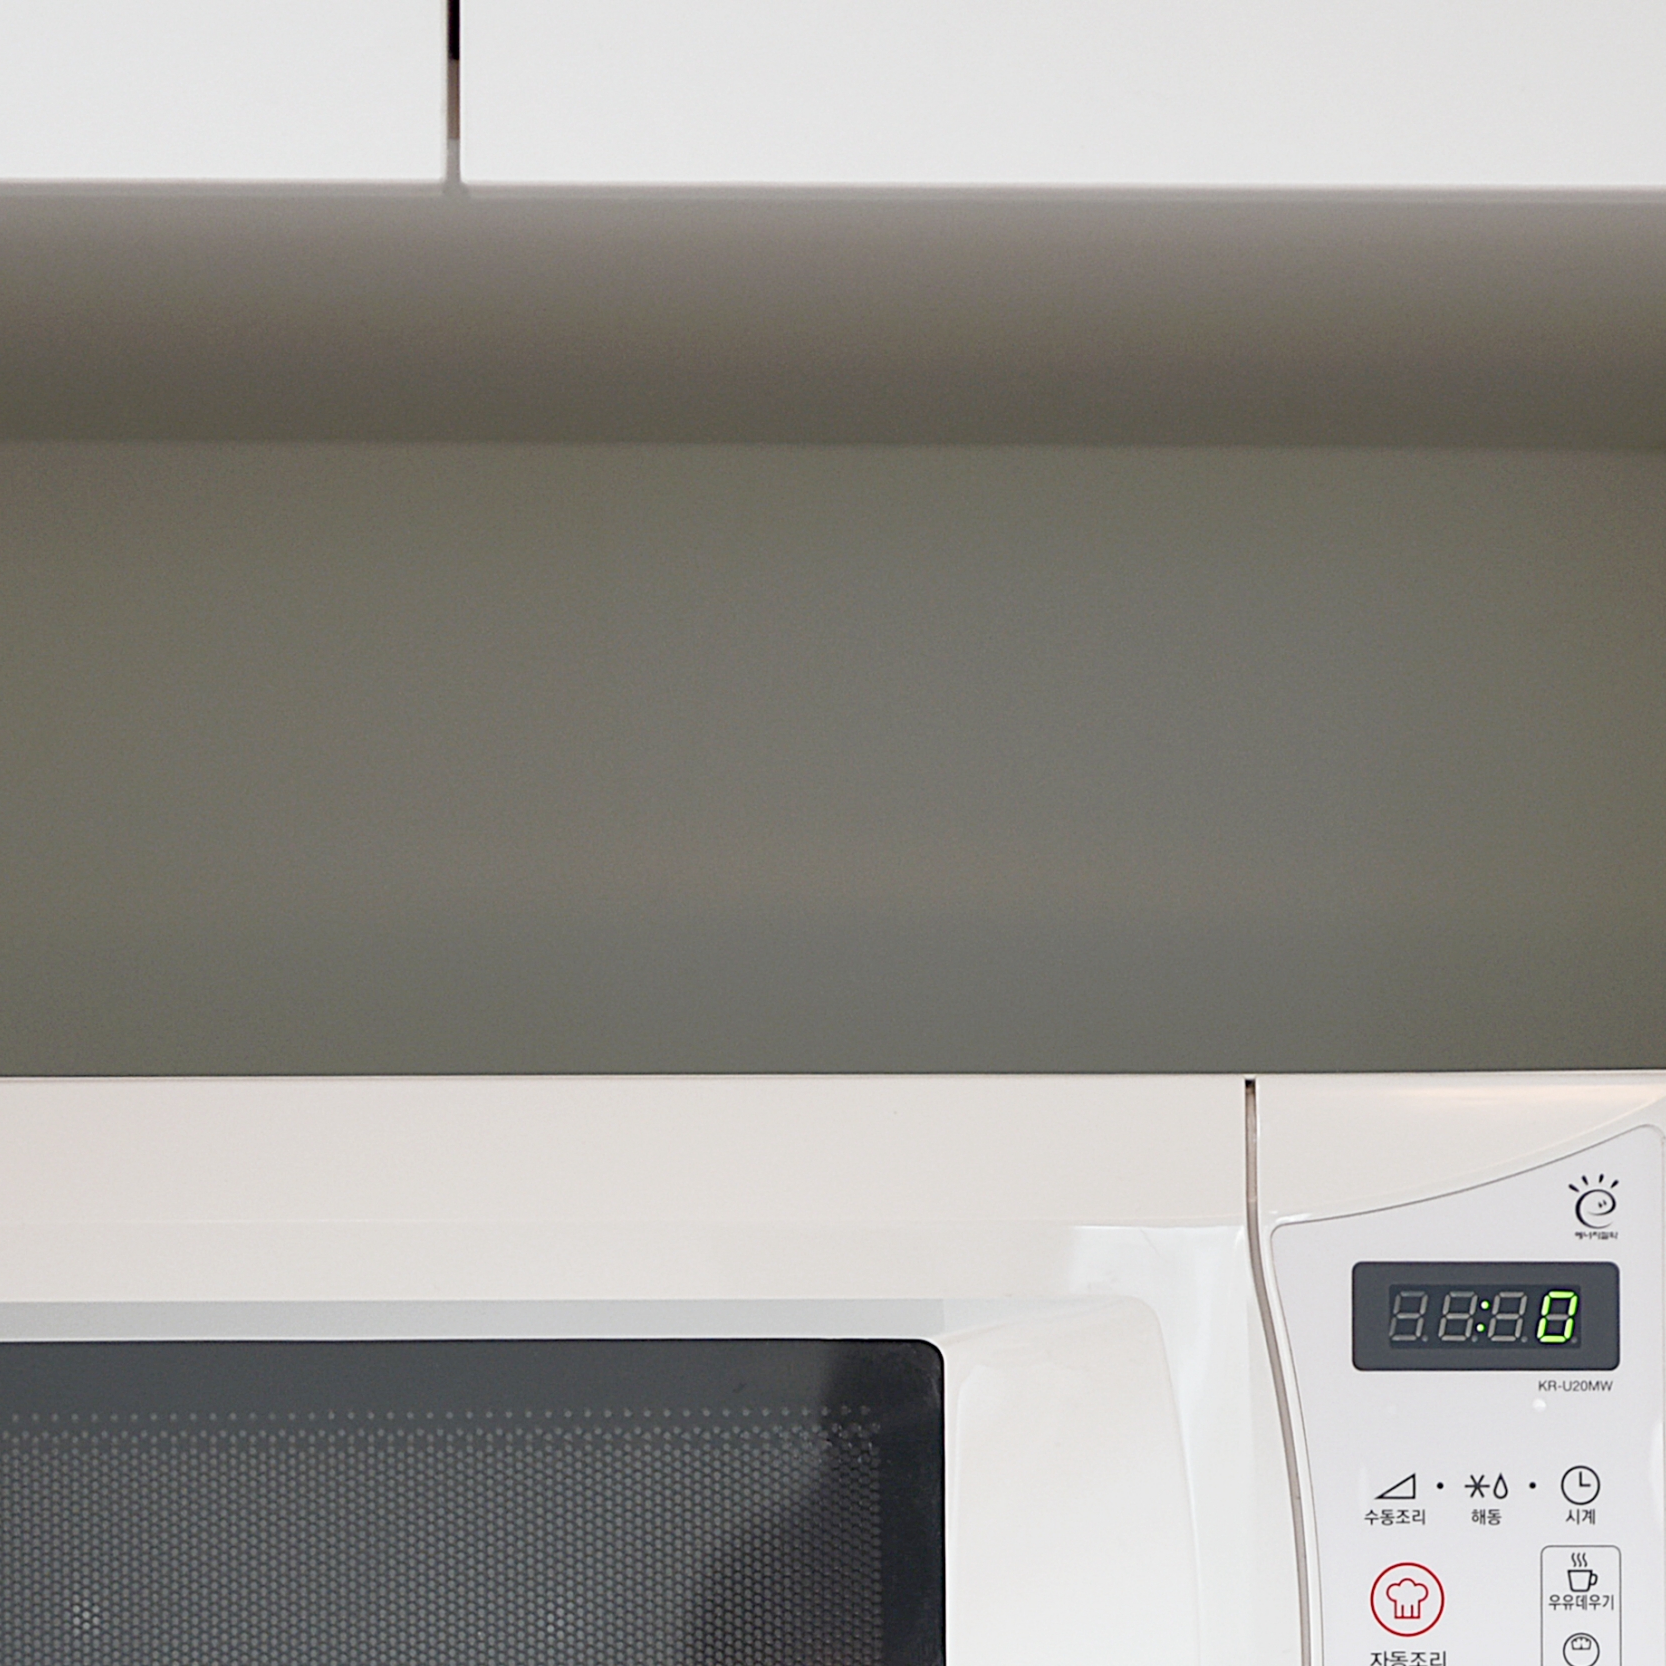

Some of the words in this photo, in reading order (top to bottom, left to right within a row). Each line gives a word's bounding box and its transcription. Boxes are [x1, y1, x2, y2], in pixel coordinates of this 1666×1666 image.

[1538, 1380, 1613, 1392] KR-U20MW
[1364, 1509, 1426, 1526] 수동조리
[1471, 1508, 1502, 1526] 해동
[1565, 1509, 1596, 1525] 시계
[1548, 1594, 1614, 1611] 우유데우기
